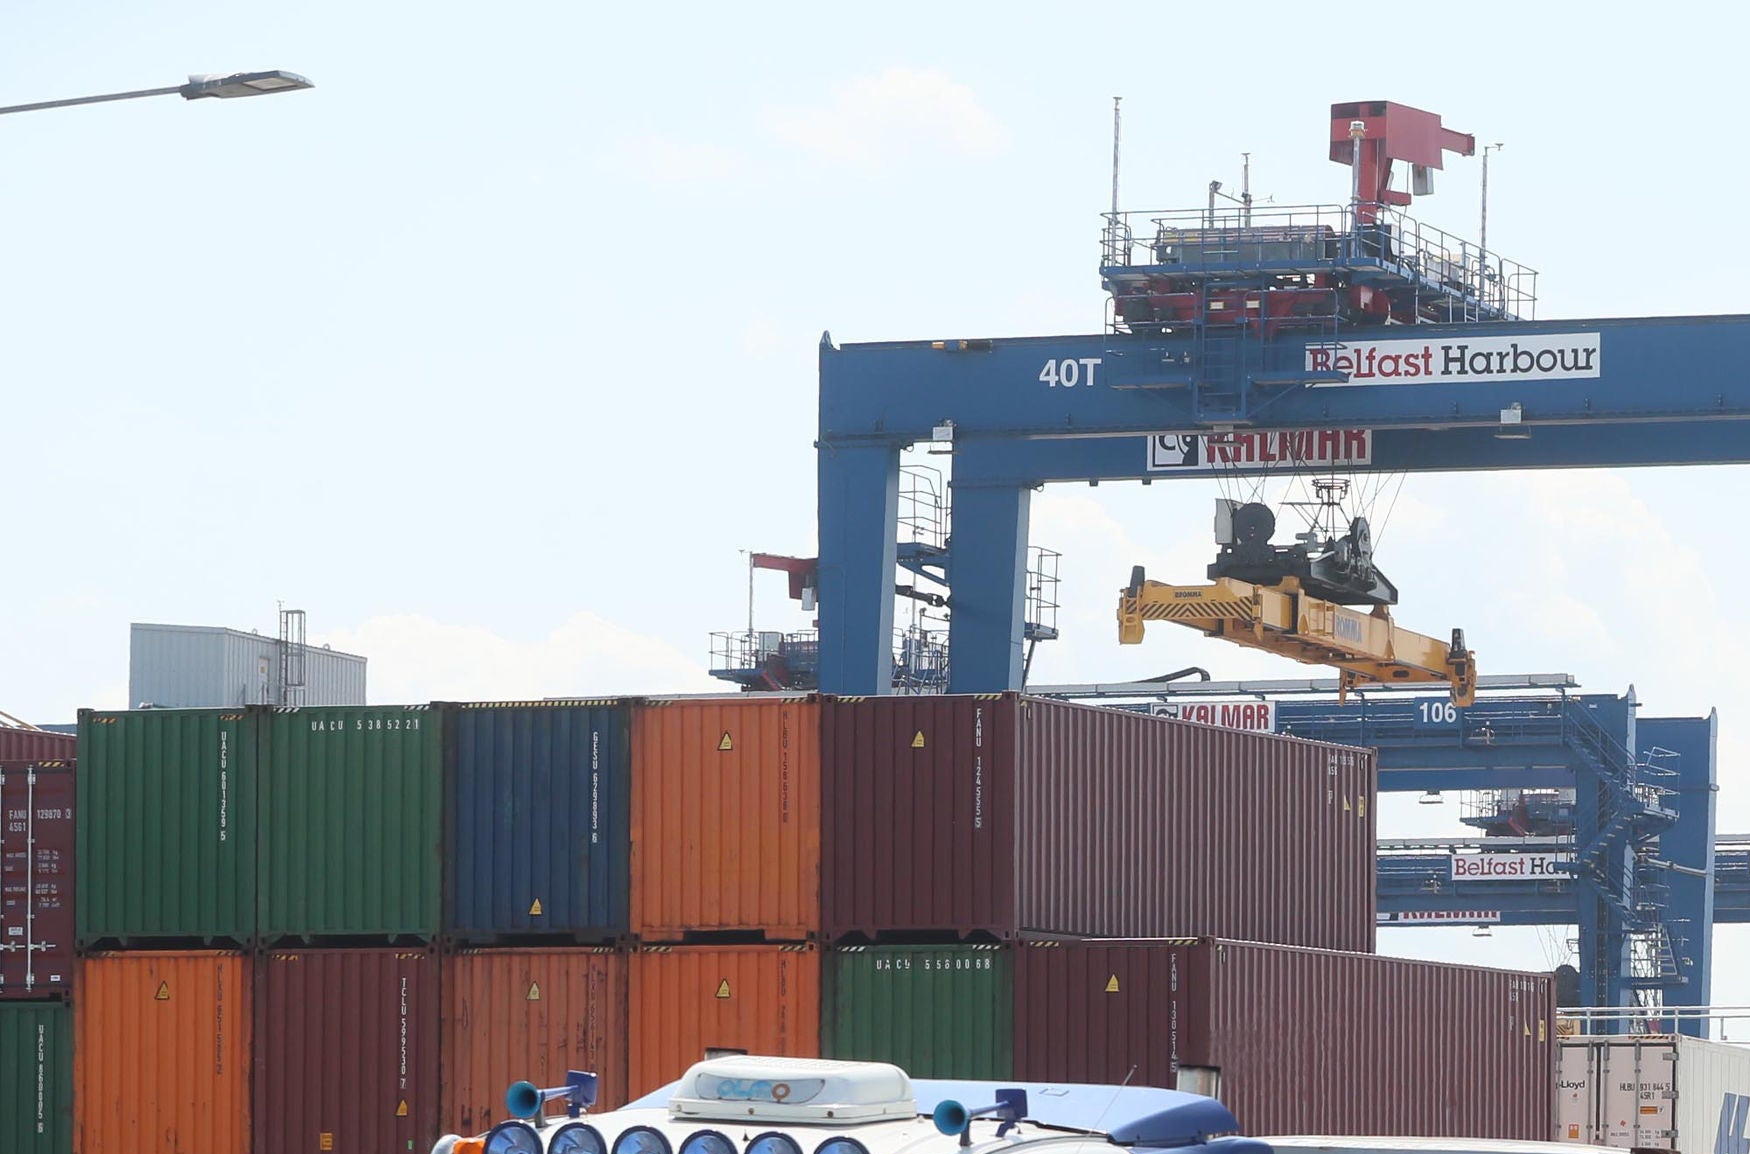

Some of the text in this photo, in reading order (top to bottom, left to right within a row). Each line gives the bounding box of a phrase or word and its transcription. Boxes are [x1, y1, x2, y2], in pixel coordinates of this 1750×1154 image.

[1308, 342, 1597, 379] Belfast Harbour
[1038, 357, 1103, 388] 40T
[1335, 611, 1363, 643] ROMMA
[1418, 701, 1459, 724] 106
[311, 720, 344, 731] UACU
[974, 708, 983, 747] FANU
[974, 756, 983, 816] 124555
[9, 810, 27, 820] FANU
[1453, 858, 1526, 876] Belfast
[876, 959, 910, 970] UACU
[1556, 1079, 1585, 1090] -Lloyd
[1620, 1083, 1635, 1091] HLBU
